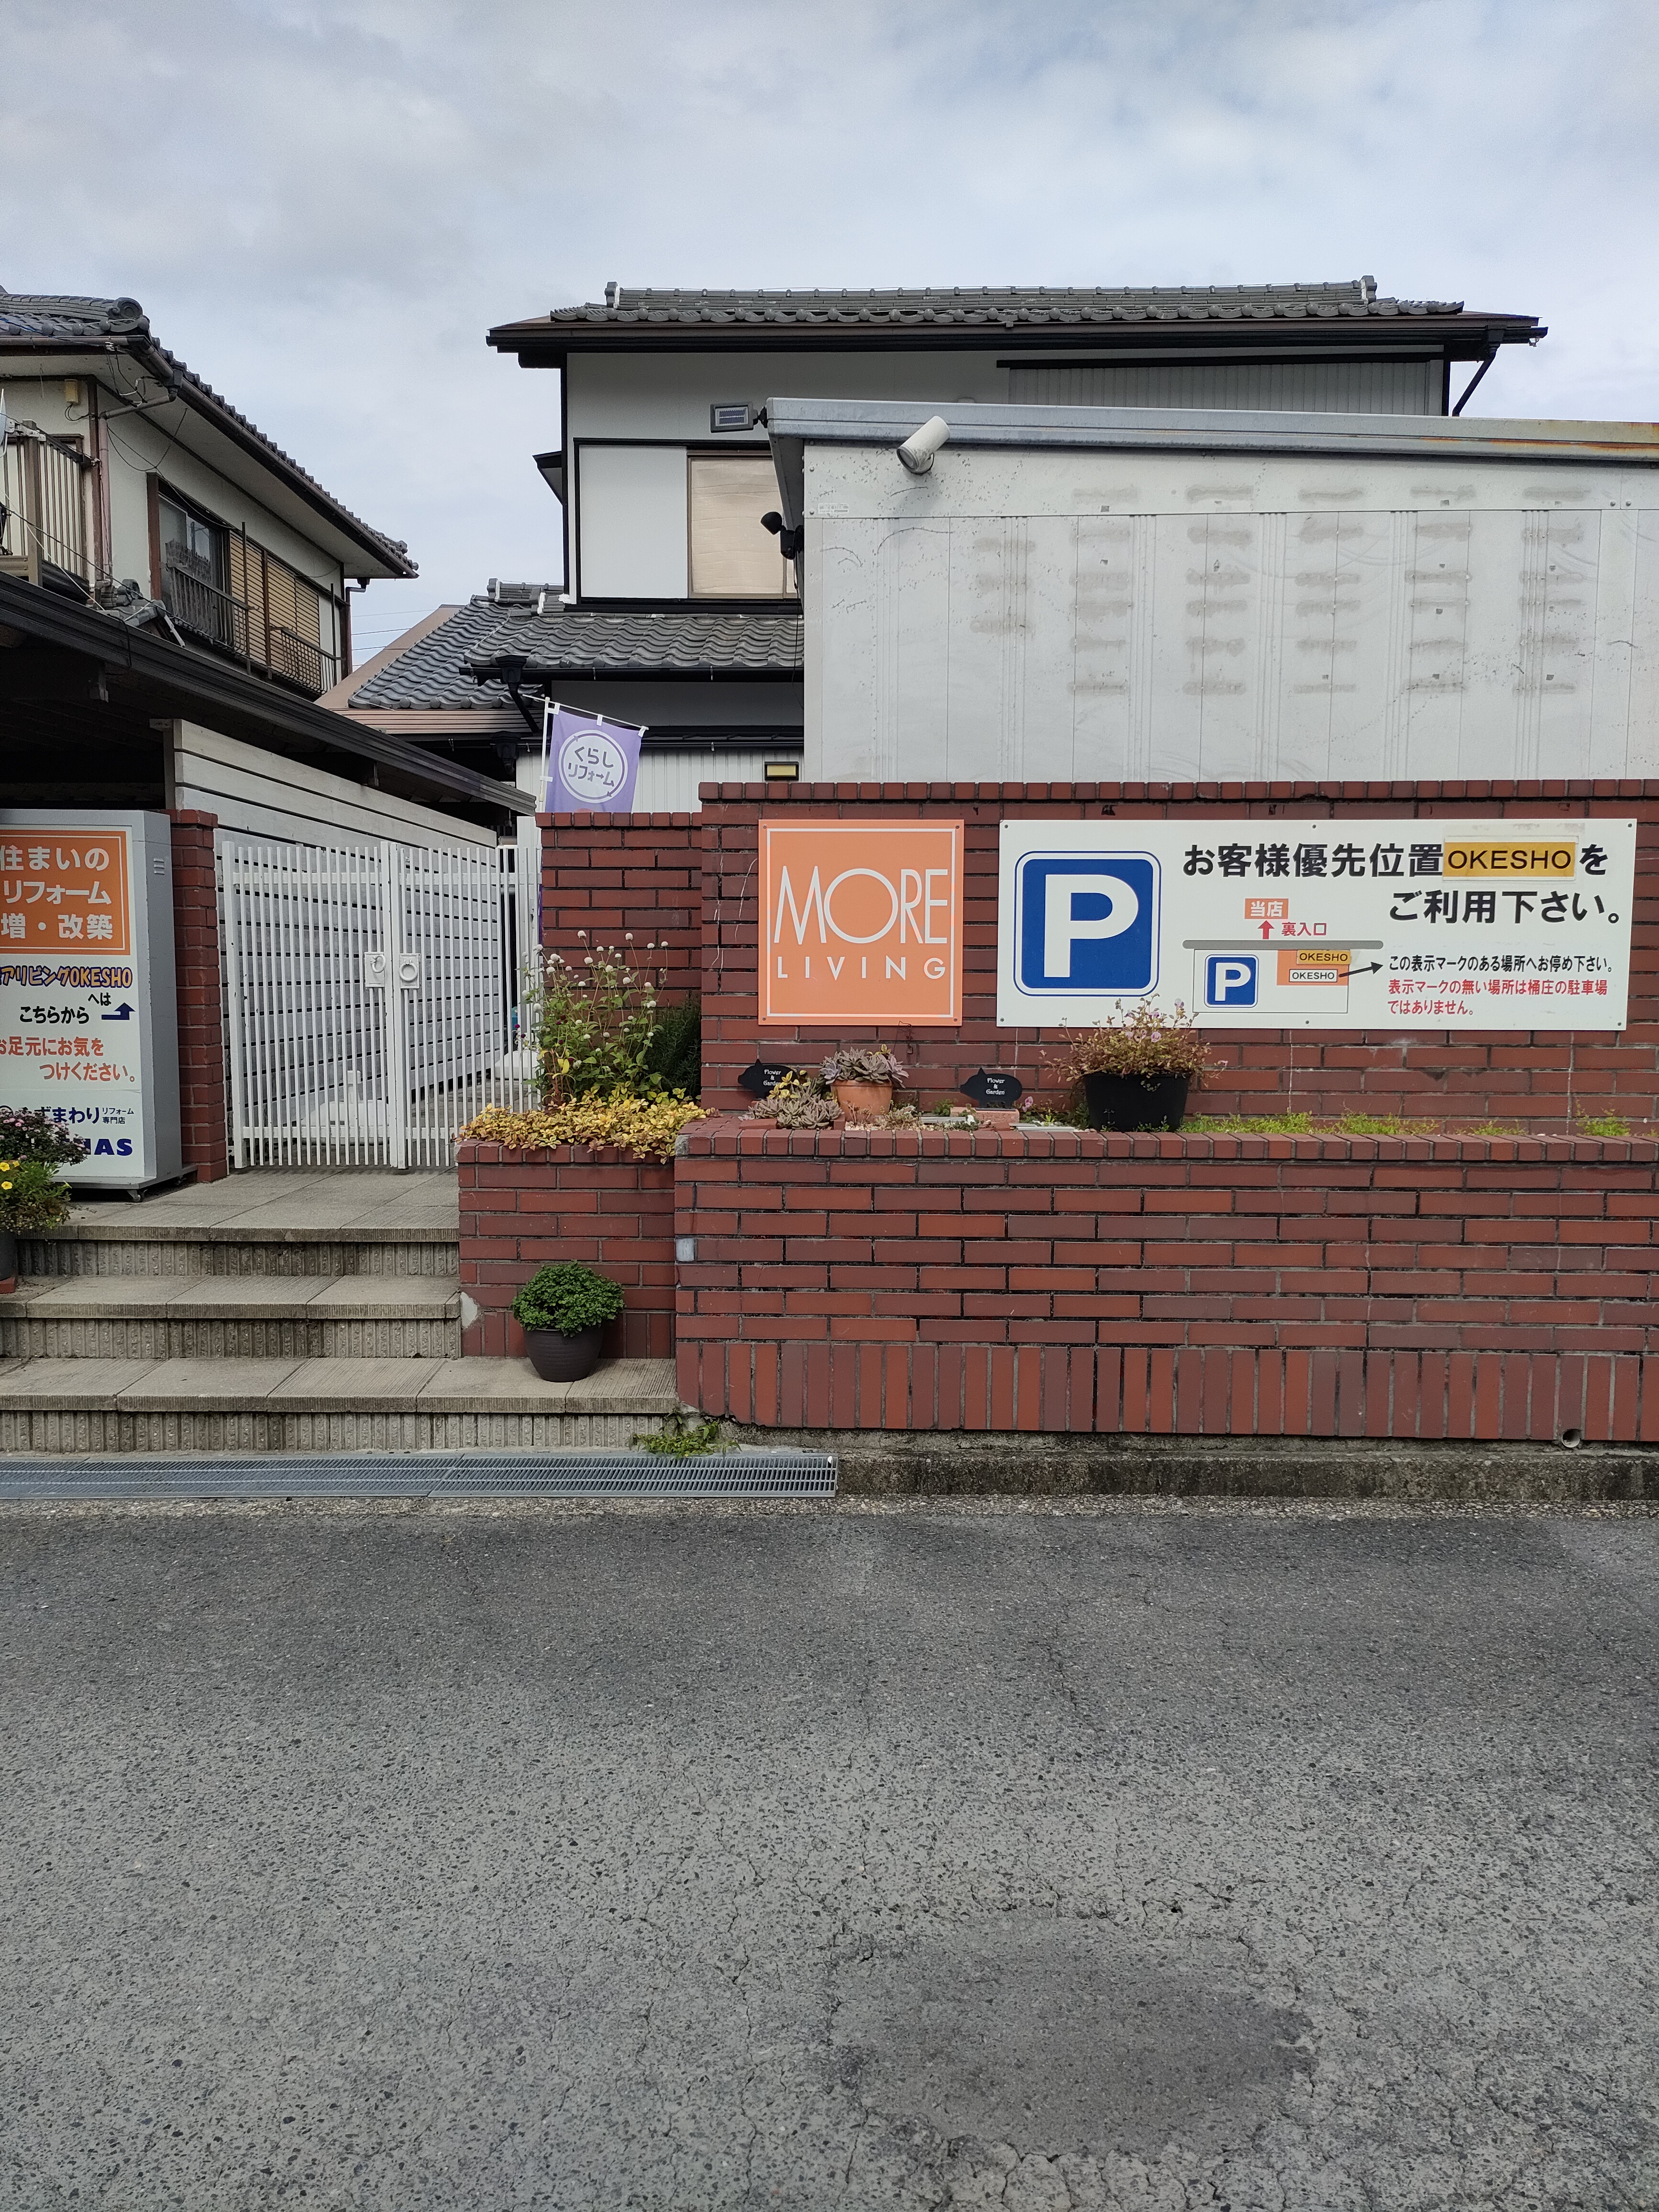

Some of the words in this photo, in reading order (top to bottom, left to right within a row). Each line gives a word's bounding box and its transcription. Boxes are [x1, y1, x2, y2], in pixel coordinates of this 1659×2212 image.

[574, 746, 614, 768] くらし
[568, 762, 615, 787] リフォーム
[0, 844, 110, 871] 住まいの
[1183, 843, 1443, 877] お客様優先位置
[1448, 850, 1571, 870] OKESHO
[1579, 844, 1608, 875] を
[3, 880, 112, 905] リフォーム
[774, 866, 948, 945] MORE
[1250, 901, 1283, 917] 当店
[1389, 890, 1619, 924] ご利用下さい。
[1044, 874, 1139, 978] P
[1281, 922, 1327, 936] 裏入口
[777, 955, 946, 981] LIVING
[1299, 953, 1348, 962] OKESHO
[1389, 955, 1612, 973] この表示マークのある場所へお停め下さい。
[0, 965, 133, 988] アリビングOKESHO
[1215, 962, 1251, 1001] P
[1292, 972, 1335, 980] OKESHO
[1388, 979, 1608, 995] 表示マークの無い場所は桶庄の駐車場
[88, 992, 111, 1006] へは
[1387, 1000, 1473, 1016] ではありません。
[20, 1006, 89, 1024] こちらから
[39, 1061, 135, 1083] つけください。
